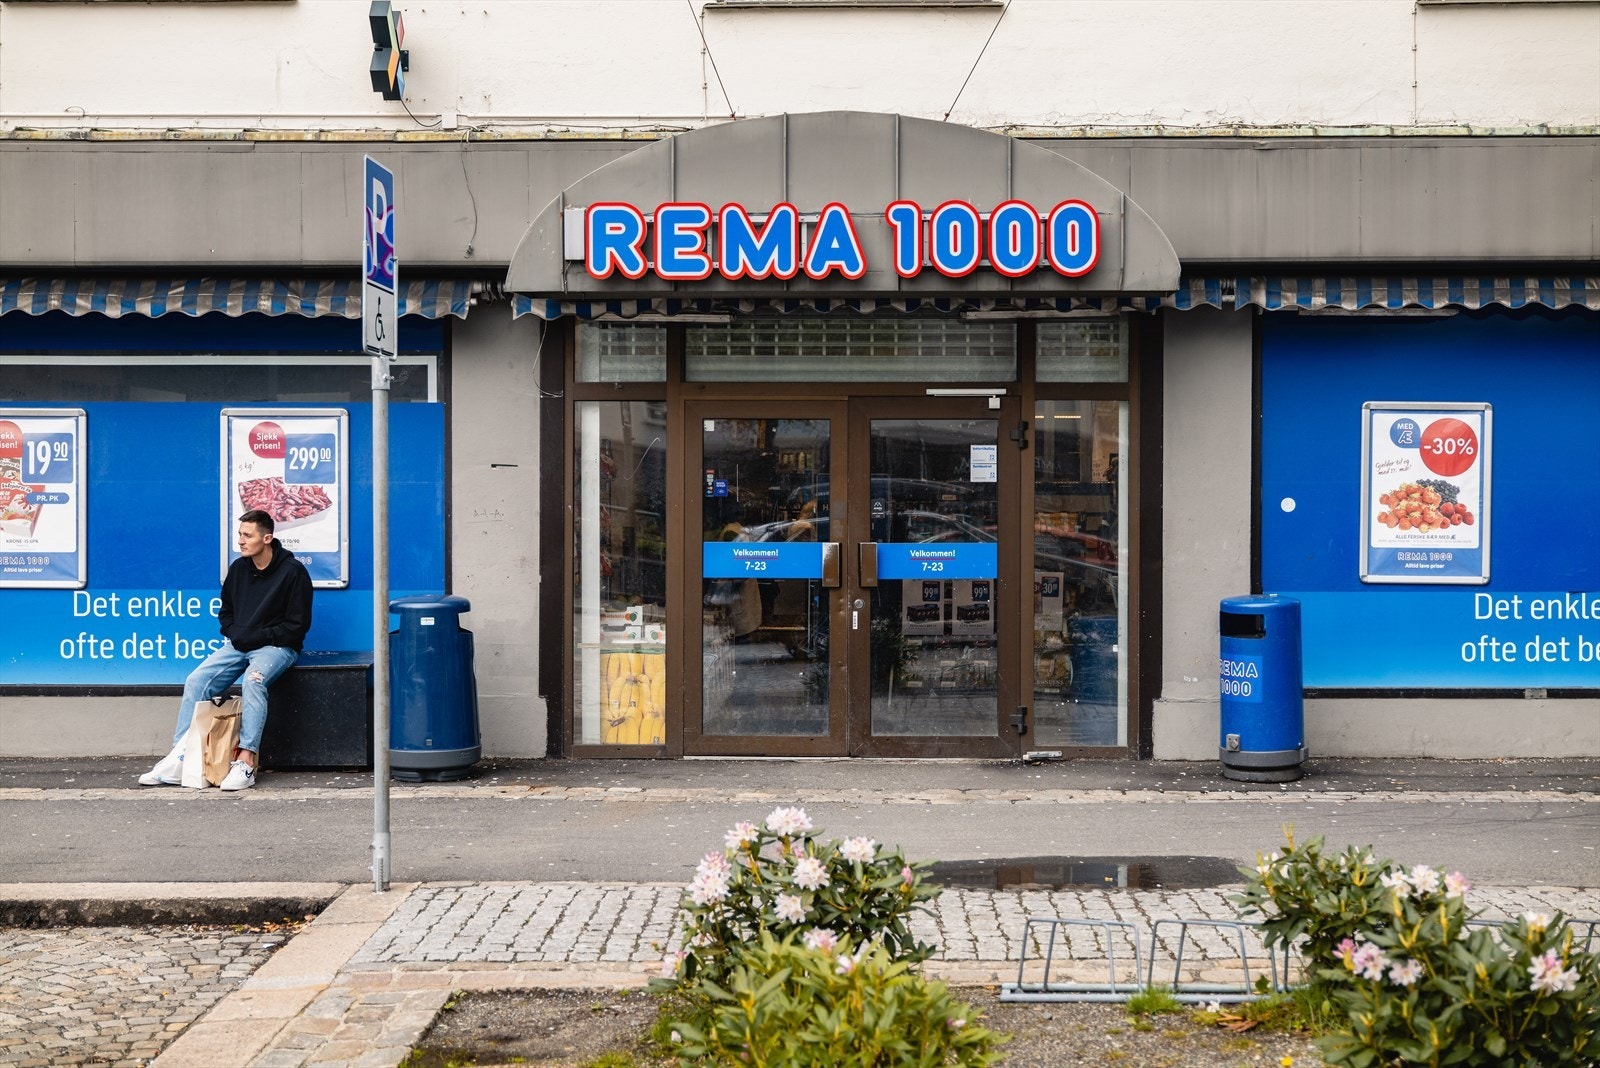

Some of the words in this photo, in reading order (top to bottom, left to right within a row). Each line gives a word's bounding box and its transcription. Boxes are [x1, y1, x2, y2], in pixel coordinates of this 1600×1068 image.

[585, 202, 867, 282] REMA
[885, 199, 1100, 280] 1000
[256, 433, 278, 441] Sjekk
[1398, 430, 1413, 444] Æ
[253, 442, 281, 450] prisen!
[1423, 438, 1474, 455] -30%
[27, 440, 51, 475] 19
[53, 441, 68, 458] 90
[289, 447, 319, 470] 299
[320, 448, 332, 459] 00
[733, 549, 779, 557] Velkommen!
[910, 549, 956, 557] Velkommen!
[1397, 552, 1428, 561] REMA
[1429, 552, 1453, 561] 1000
[27, 556, 50, 566] 1000
[745, 561, 767, 571] 7-23
[922, 562, 944, 571] 7-23
[73, 590, 120, 617] Det
[127, 590, 201, 617] enkle
[1475, 593, 1523, 620] Det
[1530, 592, 1600, 620] enkle
[60, 632, 114, 659] ofte
[122, 632, 167, 659] det
[1461, 634, 1517, 662] ofte
[1524, 634, 1570, 662] det
